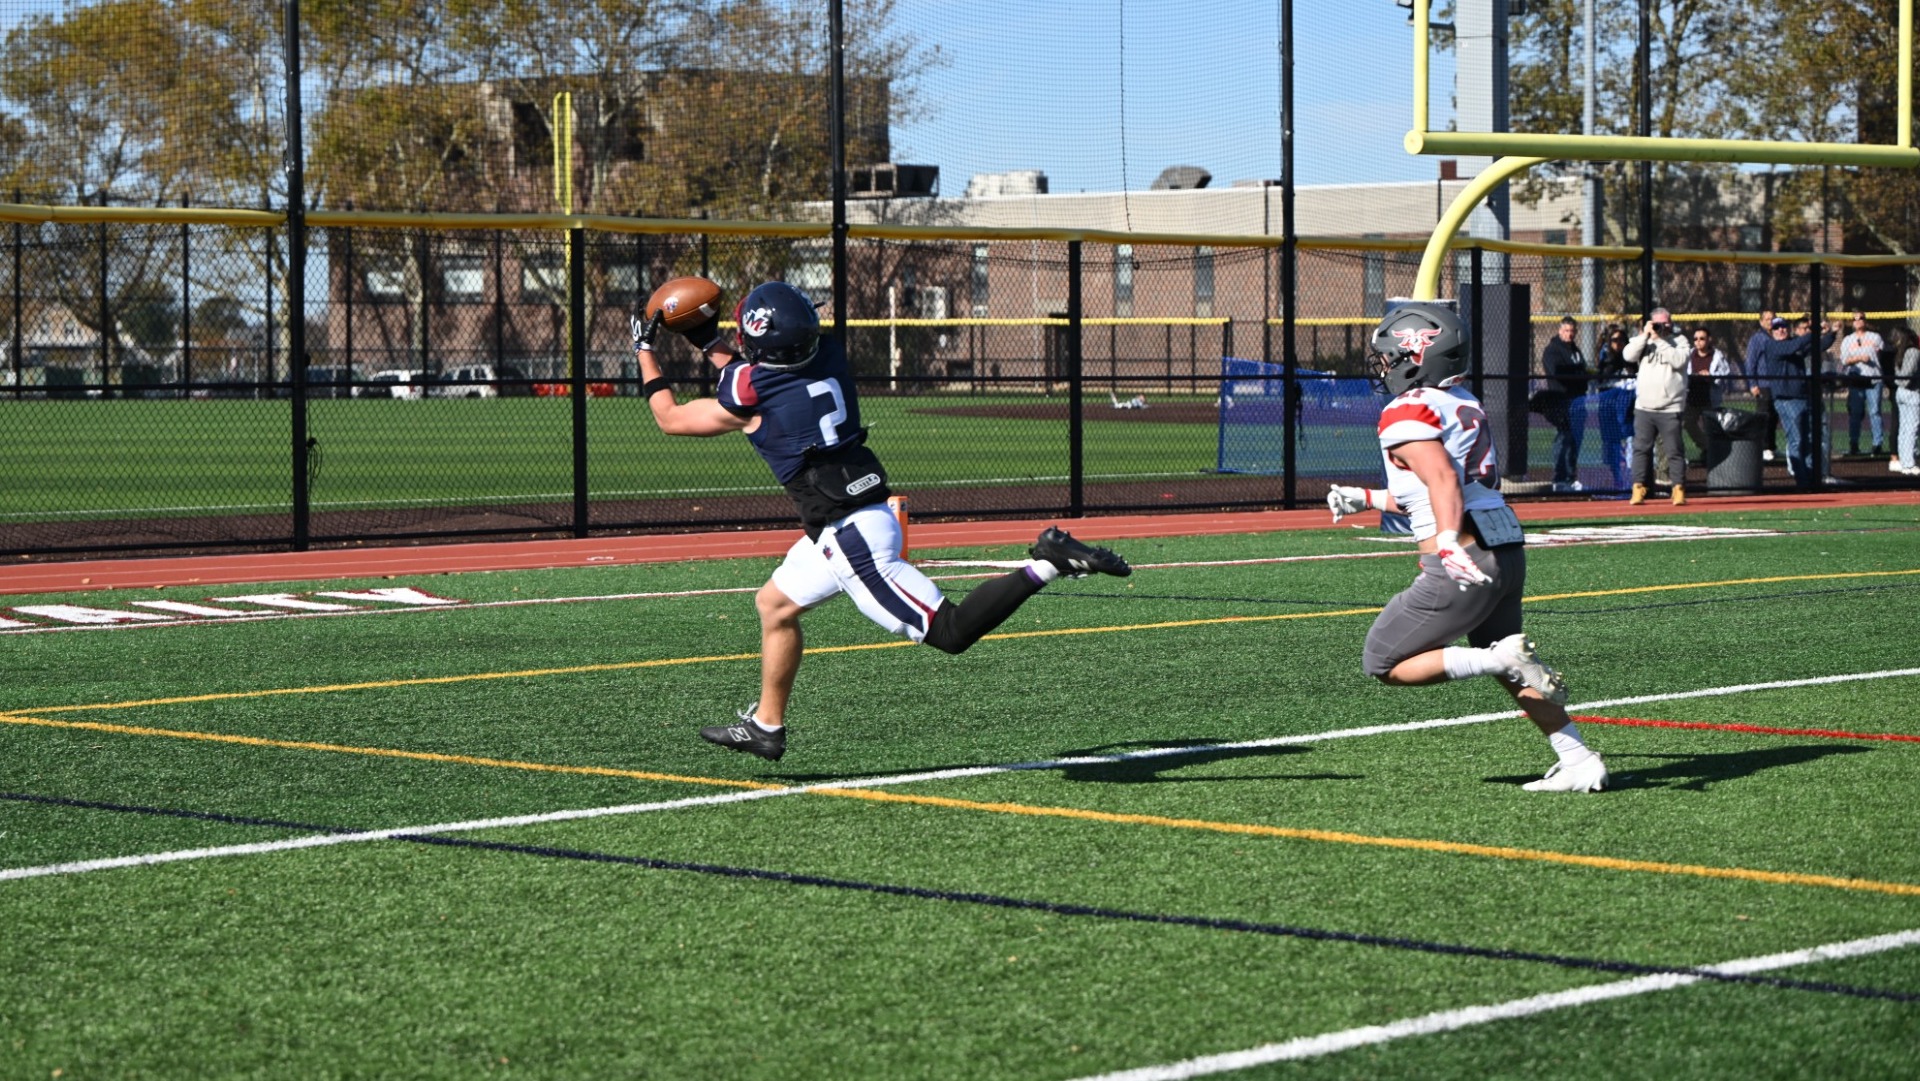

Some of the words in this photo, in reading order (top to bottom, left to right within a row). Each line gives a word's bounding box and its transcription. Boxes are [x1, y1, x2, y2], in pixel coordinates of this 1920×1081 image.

[806, 377, 847, 446] 2
[0, 586, 468, 630] ALTY
[727, 727, 752, 742] N
